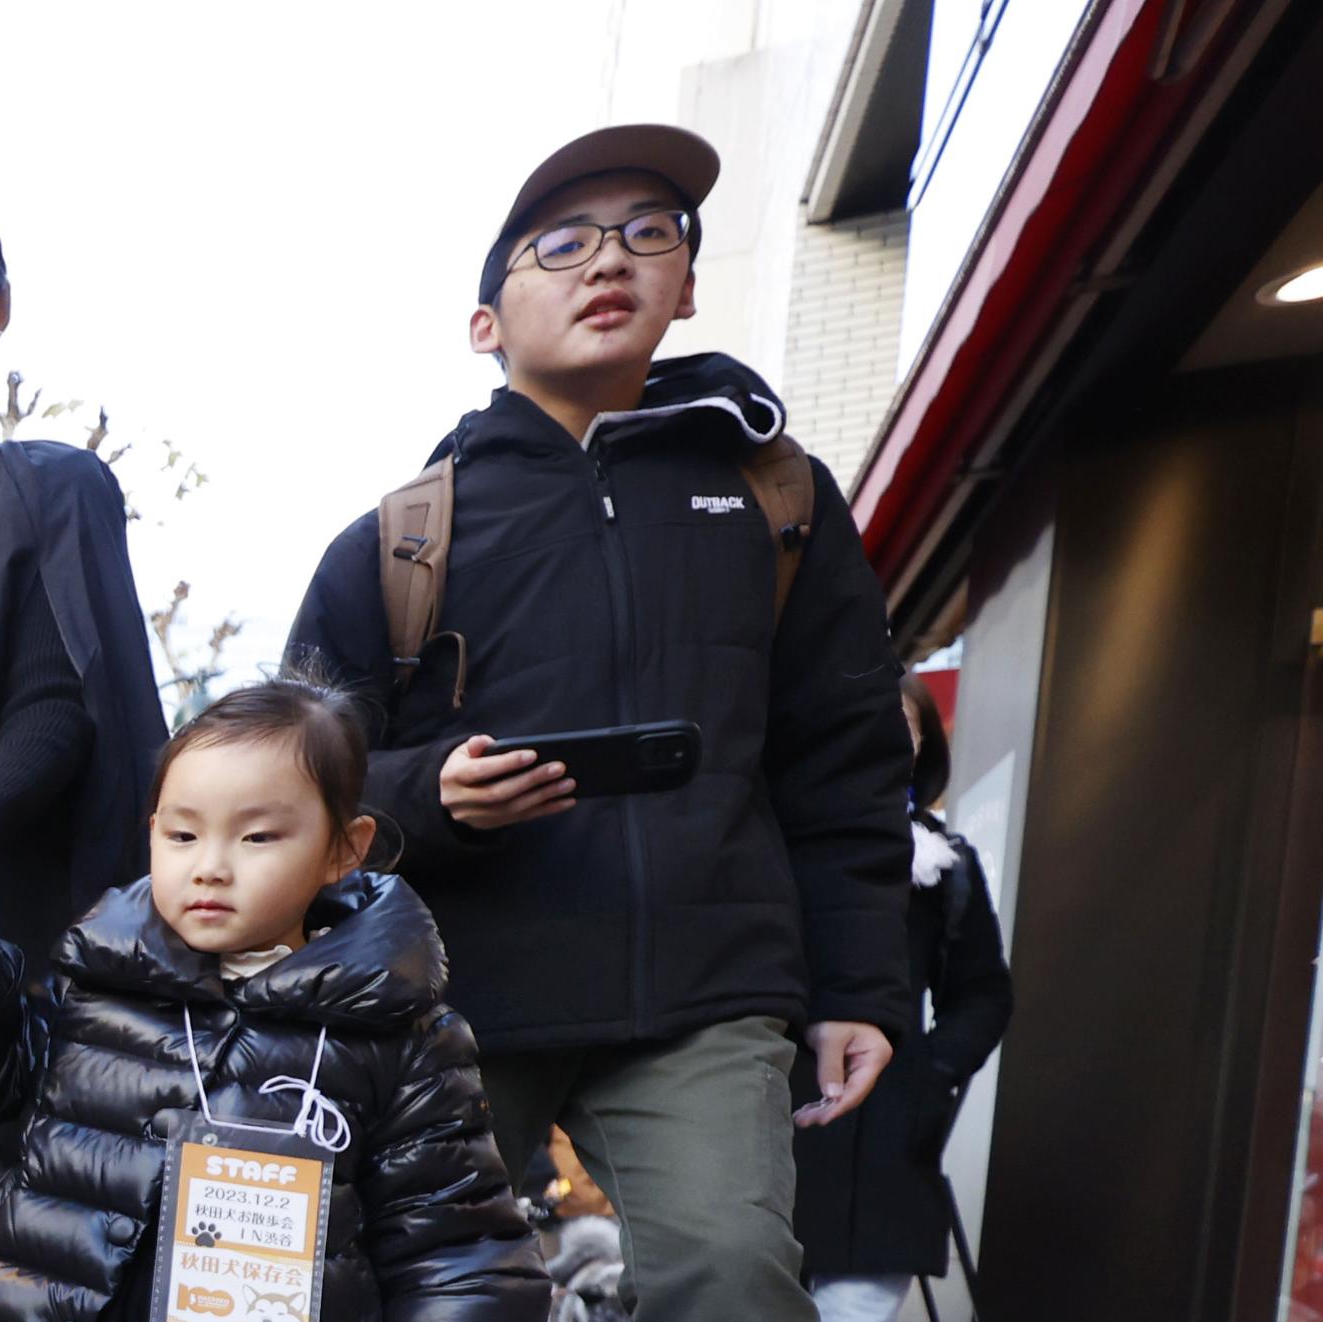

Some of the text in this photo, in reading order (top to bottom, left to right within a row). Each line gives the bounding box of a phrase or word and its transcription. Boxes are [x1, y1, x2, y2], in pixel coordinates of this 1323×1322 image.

[691, 495, 745, 509] OUTBACK
[205, 1155, 298, 1185] STAFF
[203, 1185, 291, 1210] 2023.12.2
[195, 1202, 295, 1231] 秋田犬お散歩会
[180, 1251, 305, 1287] 秋田犬保存会
